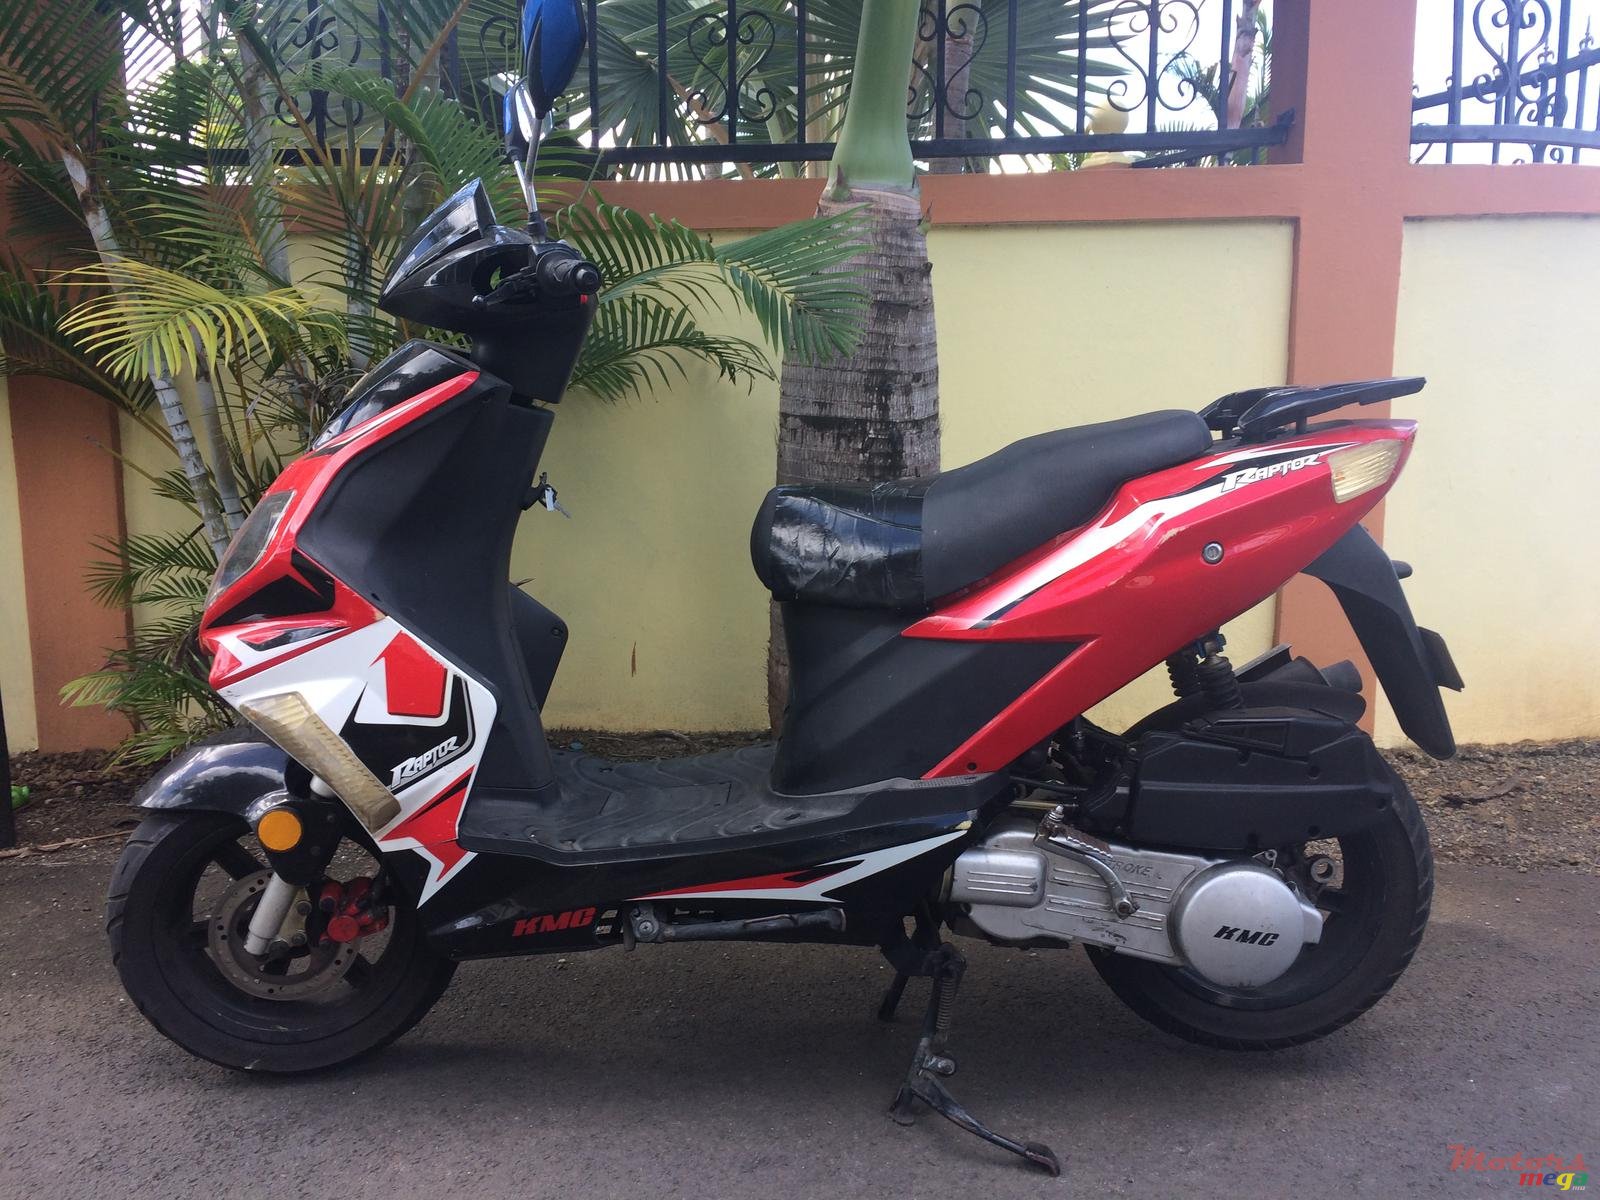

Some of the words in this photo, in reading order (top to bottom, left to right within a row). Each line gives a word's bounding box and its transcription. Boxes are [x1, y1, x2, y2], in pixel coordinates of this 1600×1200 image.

[1221, 453, 1322, 492] RAPTOR
[390, 735, 460, 788] RAPTOR
[512, 906, 597, 937] KMC
[1213, 925, 1279, 946] KMC
